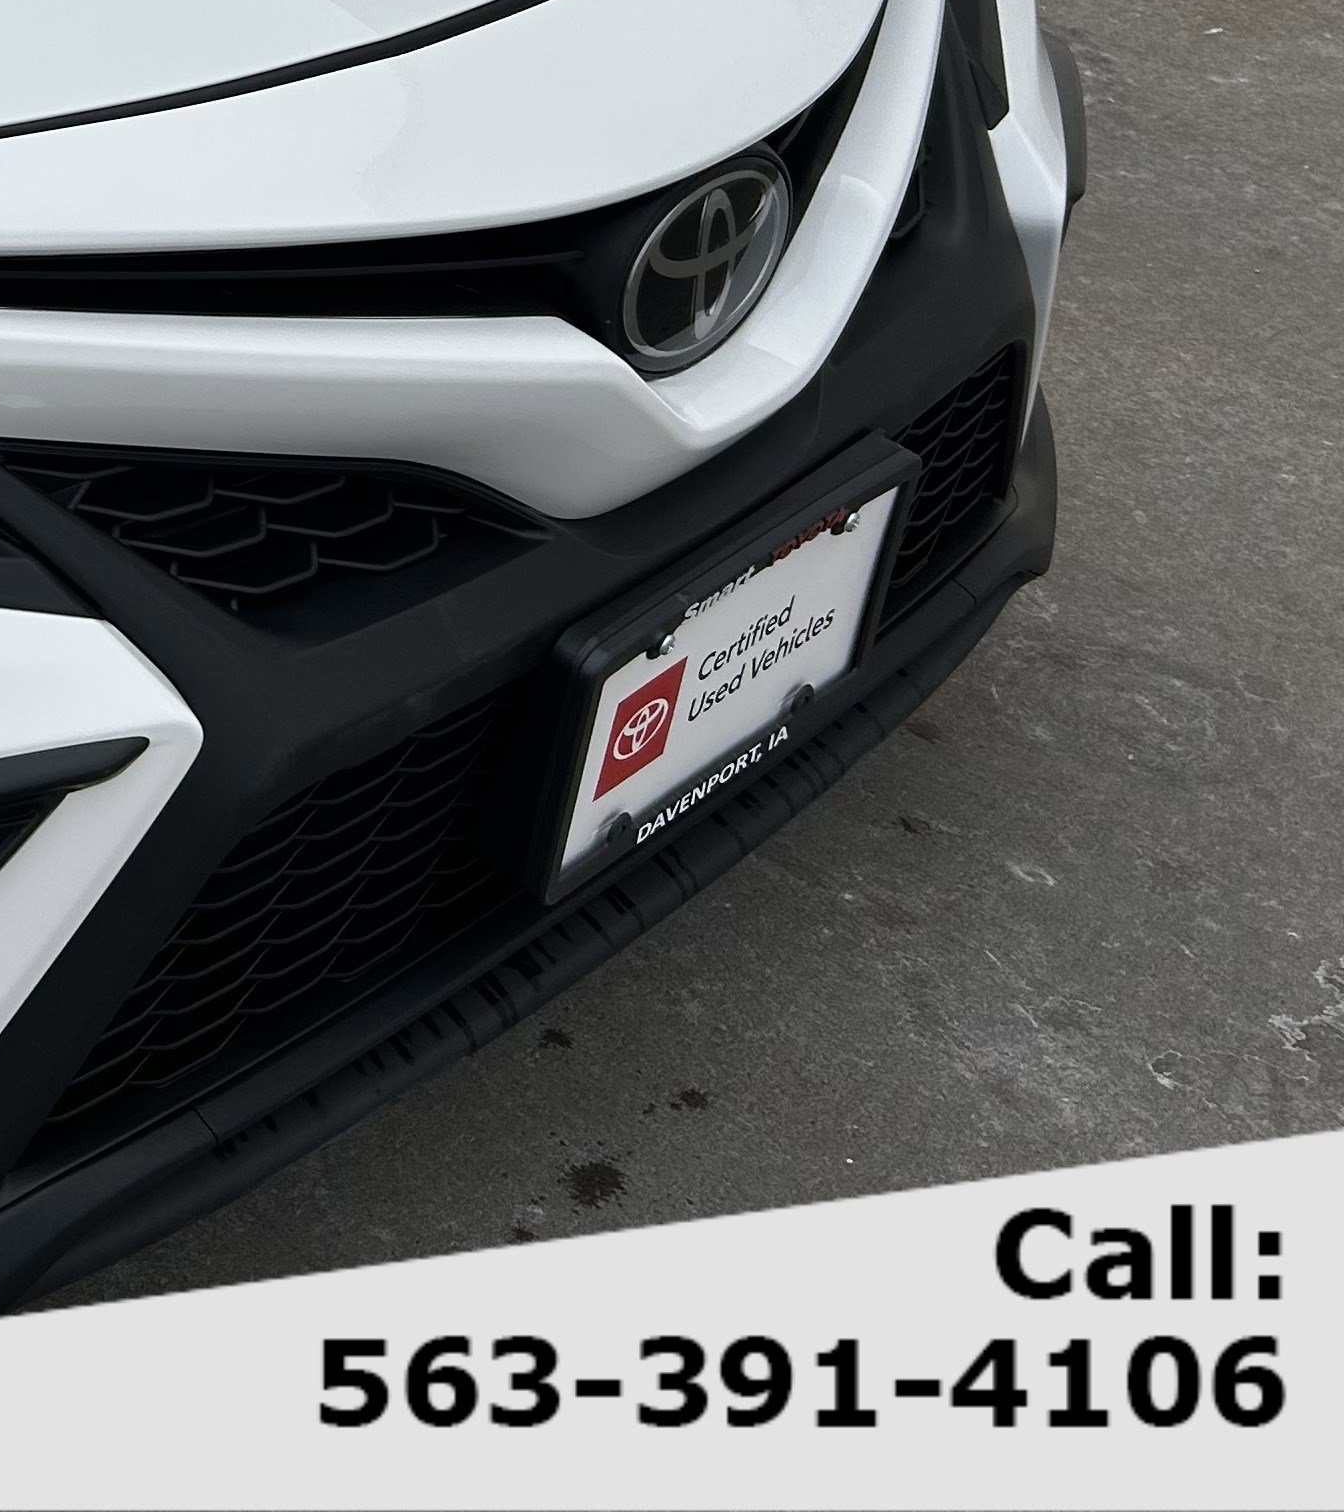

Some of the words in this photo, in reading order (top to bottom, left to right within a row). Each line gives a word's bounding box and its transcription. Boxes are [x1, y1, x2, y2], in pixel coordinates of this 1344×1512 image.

[687, 662, 747, 723] Used
[751, 607, 836, 680] Vehicles
[697, 594, 796, 681] Certified
[635, 741, 763, 846] DAVENPORT,
[767, 725, 790, 752] IA
